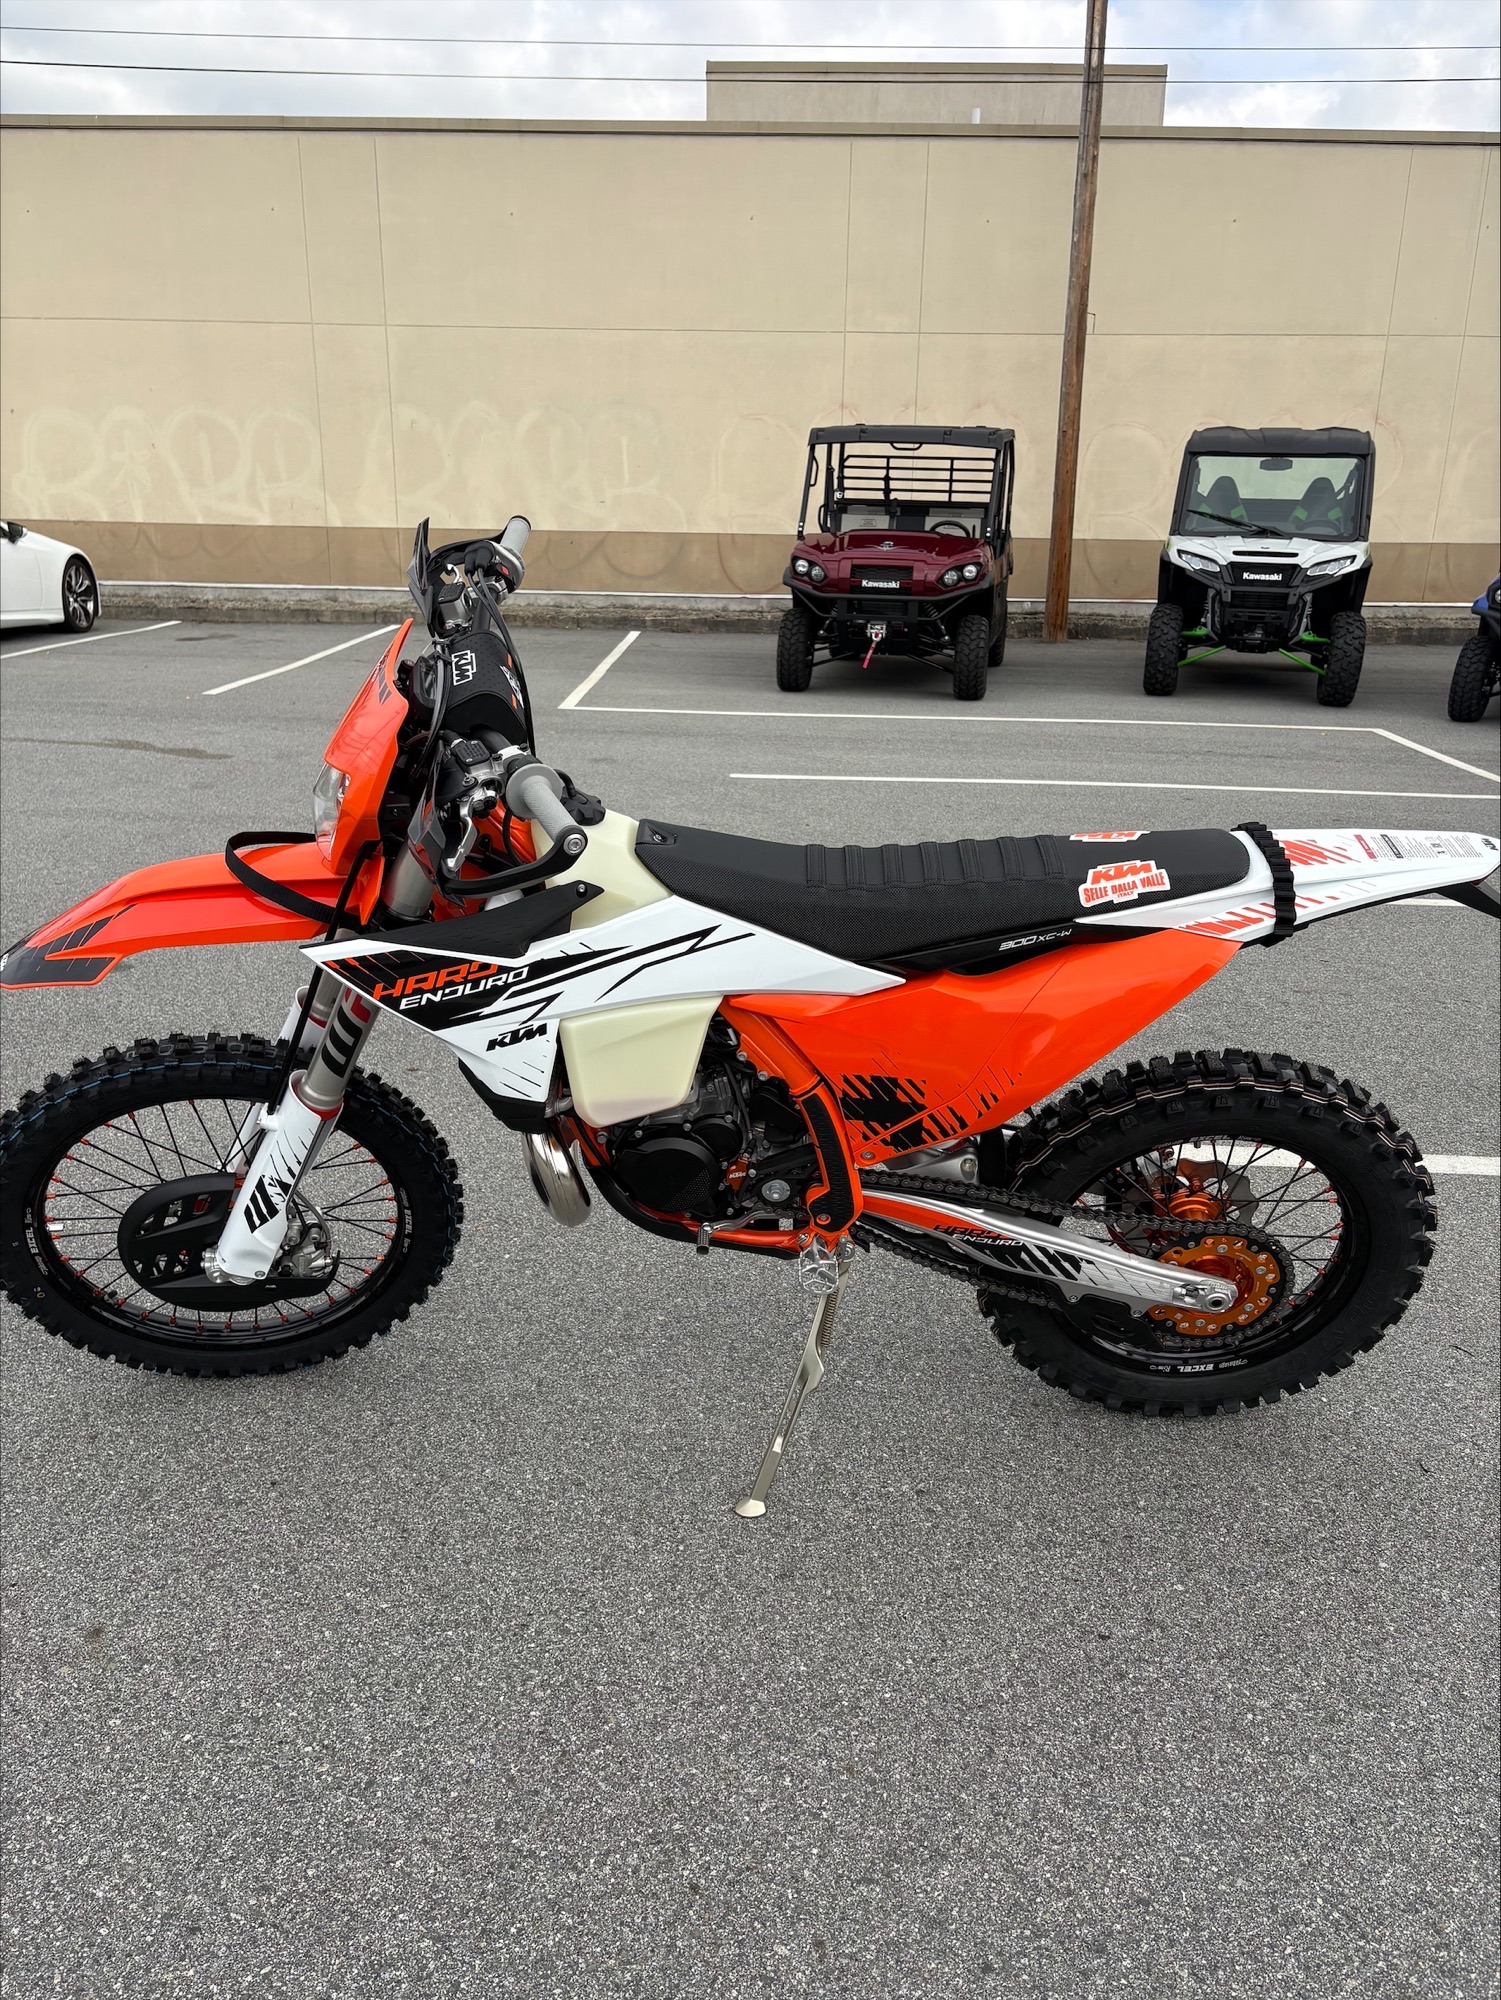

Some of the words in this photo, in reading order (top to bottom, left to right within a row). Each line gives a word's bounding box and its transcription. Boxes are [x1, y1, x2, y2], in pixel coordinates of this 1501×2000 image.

[861, 579, 900, 589] Kawasaki
[1242, 571, 1283, 581] Kawasaki
[451, 649, 477, 686] KTM
[1090, 862, 1153, 885] KTM
[1083, 886, 1109, 904] SELLE
[1110, 880, 1138, 895] DALLA
[1139, 871, 1166, 889] VALLE
[1117, 890, 1134, 899] ITALY
[372, 960, 499, 1001] HARD
[399, 966, 530, 1011] ENDURO
[485, 1022, 548, 1052] KTM
[728, 1171, 747, 1179] KTM
[25, 1226, 40, 1254] EXCEL
[952, 1233, 1025, 1246] ENDURO
[1176, 1363, 1215, 1373] EXCEL
